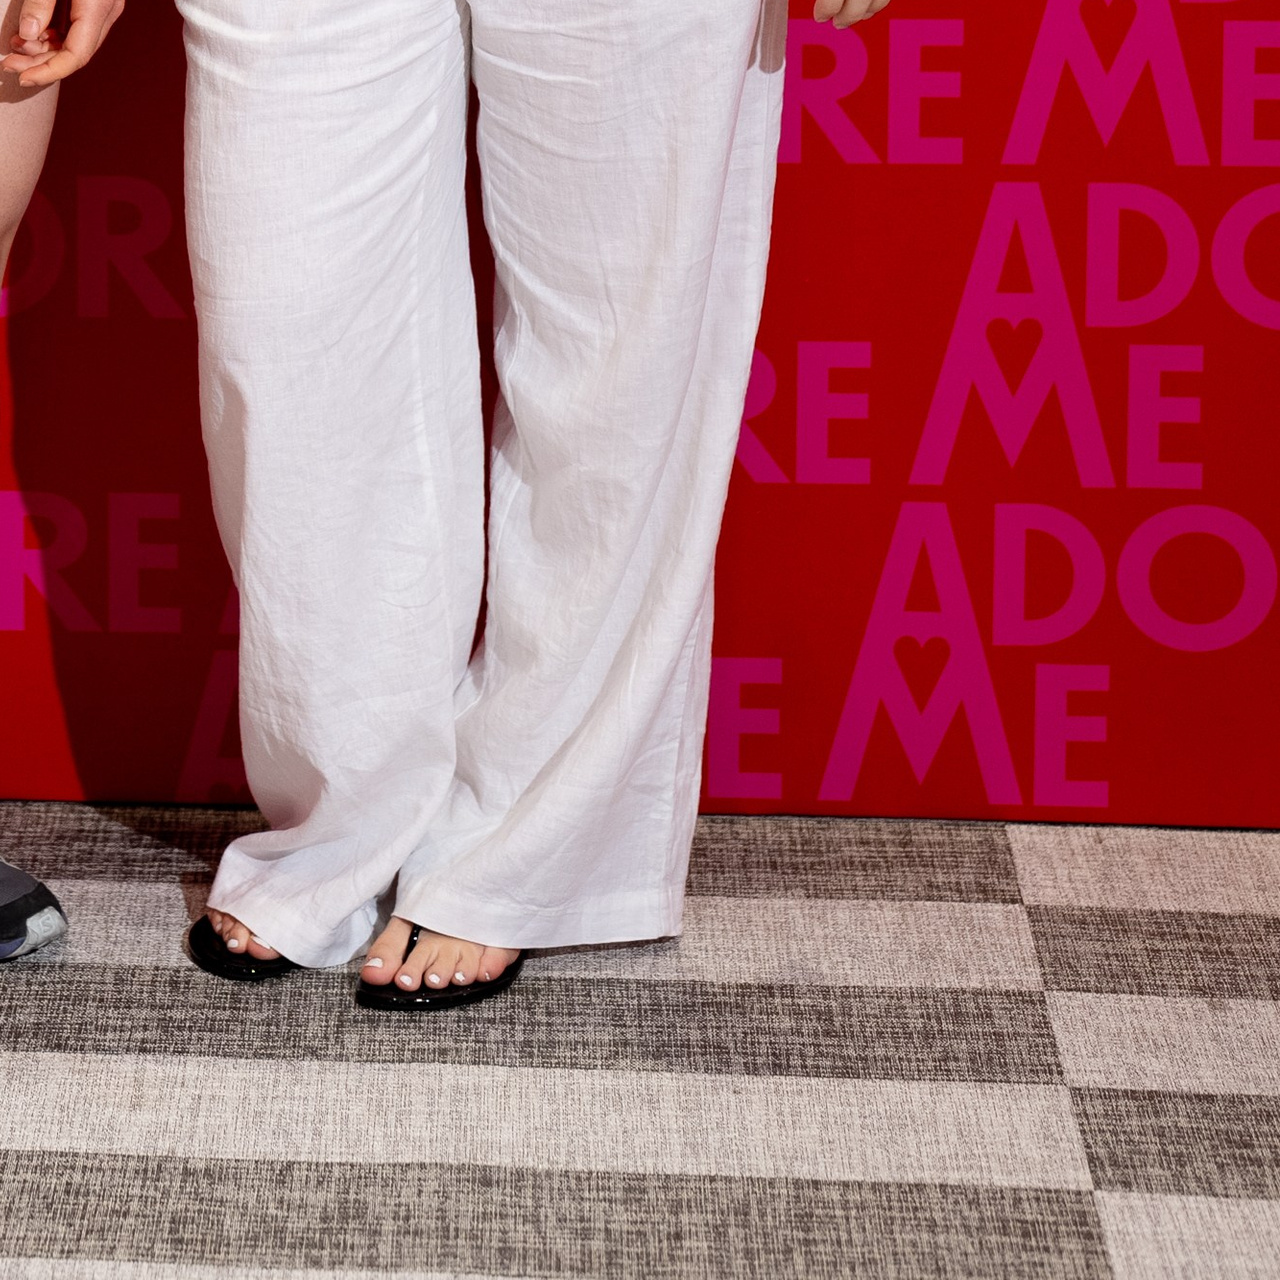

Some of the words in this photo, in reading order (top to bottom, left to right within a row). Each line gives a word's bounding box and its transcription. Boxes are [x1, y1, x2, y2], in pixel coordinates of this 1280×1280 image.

[909, 319, 1203, 489] ME
[862, 502, 1277, 651] ADO
[819, 637, 1109, 807] ME
